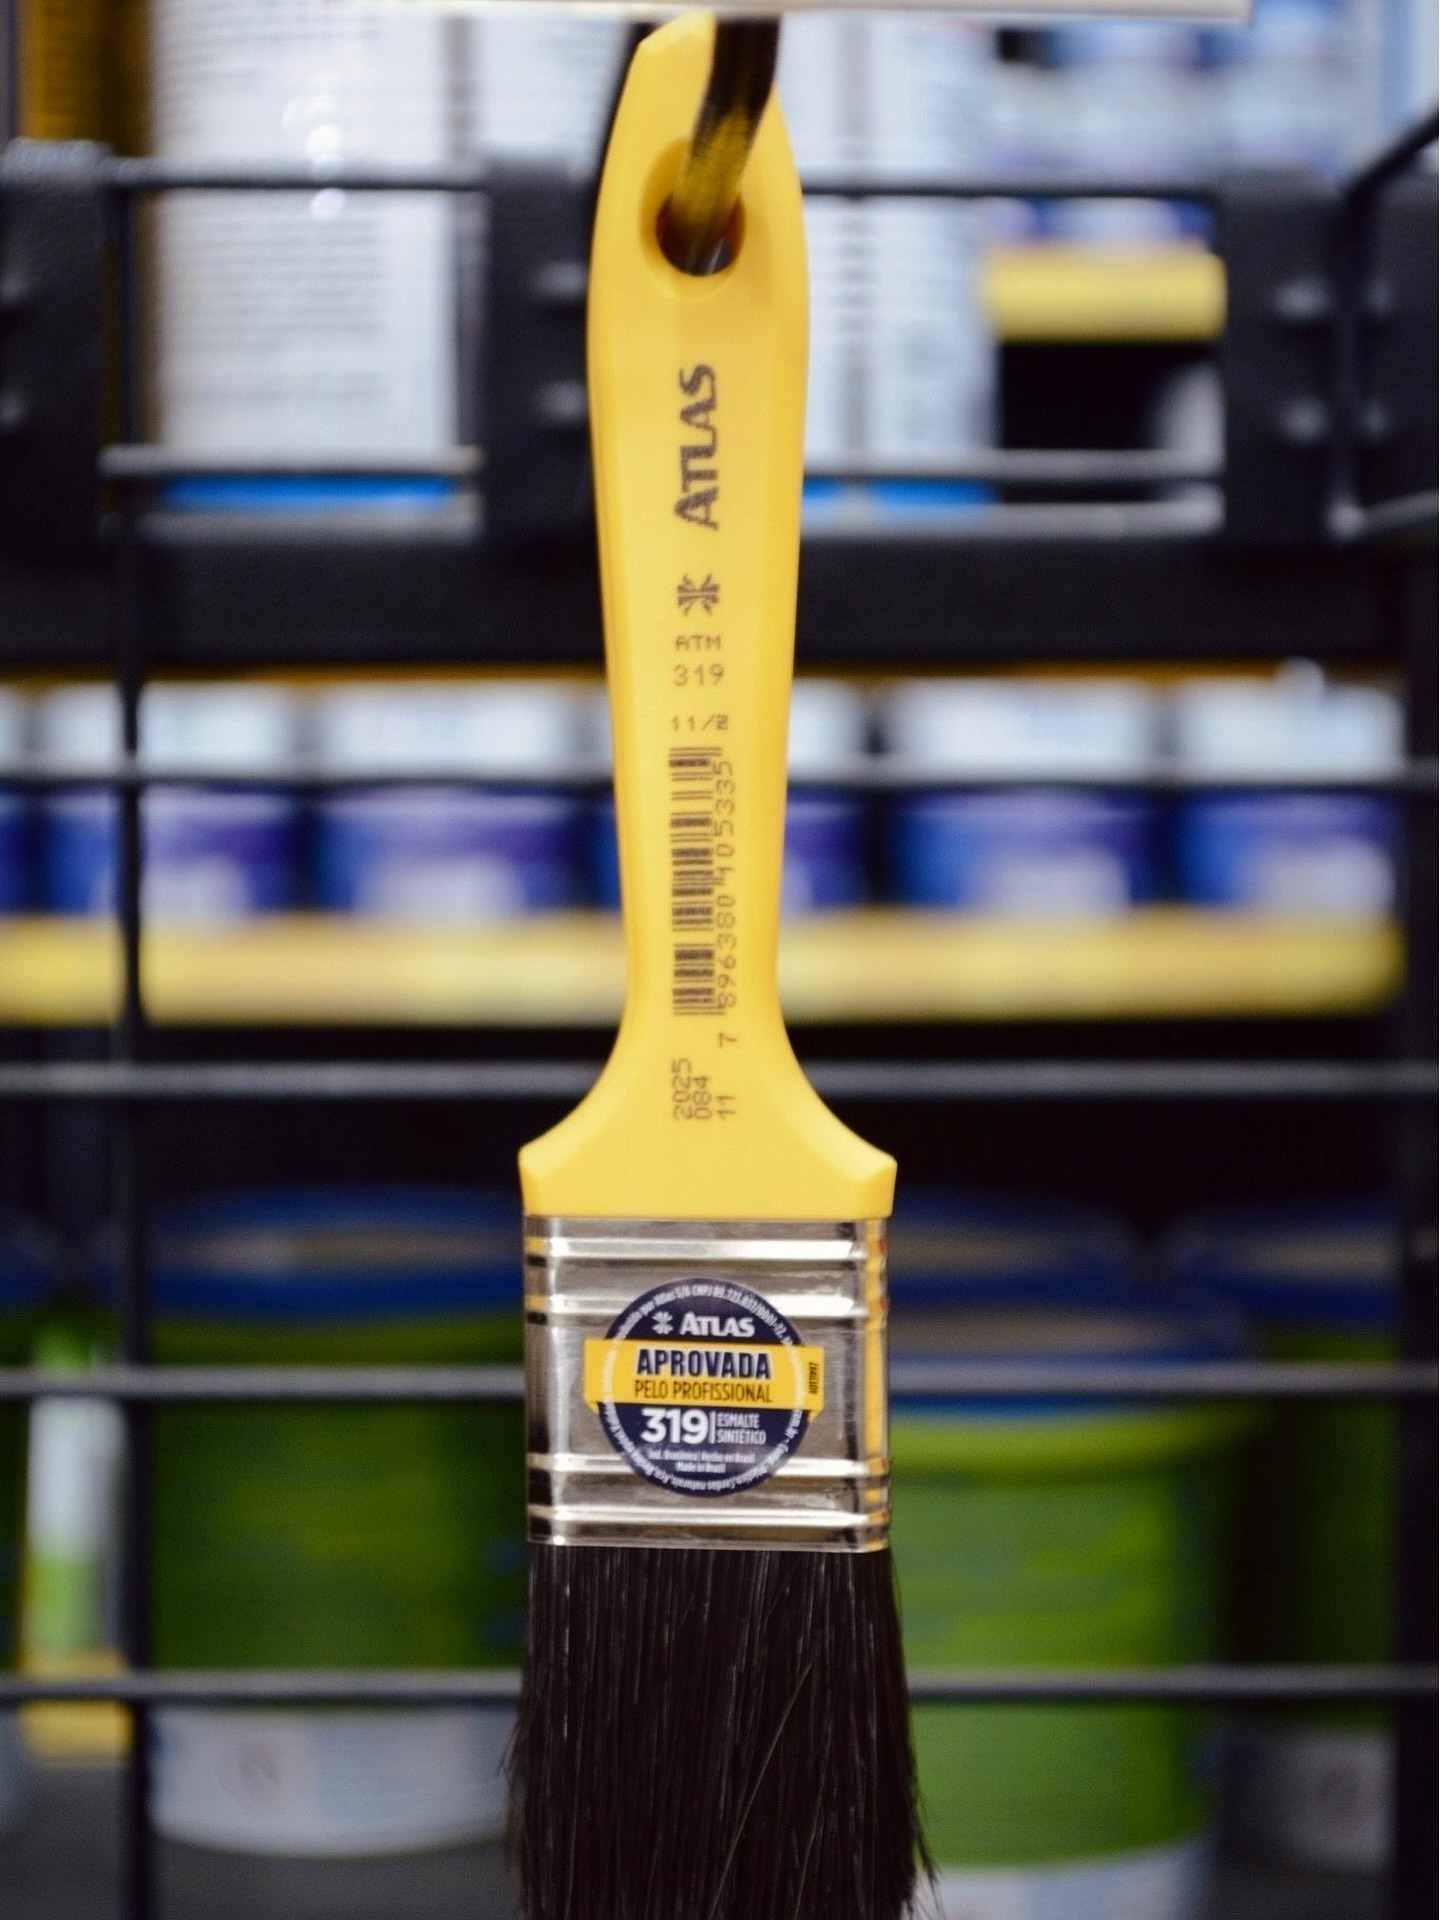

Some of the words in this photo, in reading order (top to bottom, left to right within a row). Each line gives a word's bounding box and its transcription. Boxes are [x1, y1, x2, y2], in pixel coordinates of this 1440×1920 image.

[674, 364, 720, 532] ATLAS
[675, 634, 722, 651] ATM
[673, 664, 725, 687] 319
[716, 894, 738, 1008] 896380
[717, 1032, 738, 1048] 7
[671, 1058, 692, 1120] 2025
[692, 1076, 713, 1120] 084
[679, 1311, 756, 1338] ATLAS
[636, 1348, 771, 1380] APROVADA
[635, 1380, 668, 1399] PELO
[673, 1381, 773, 1403] PROFISSIONAL
[640, 1407, 709, 1445] 319
[716, 1412, 760, 1429] ESMALTE
